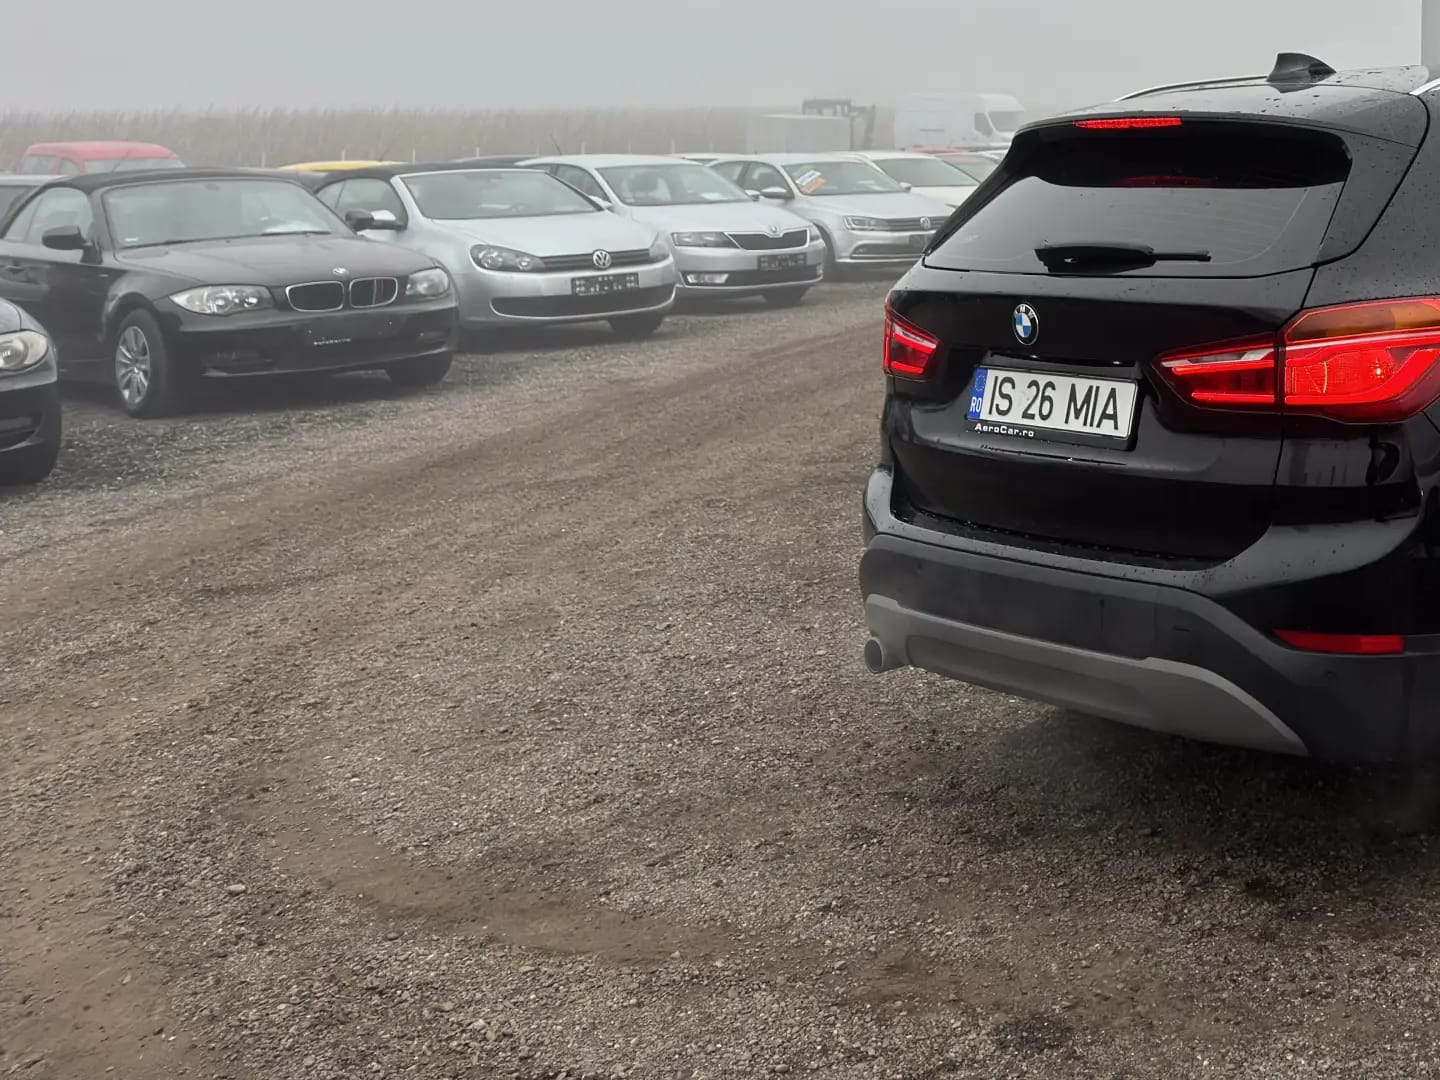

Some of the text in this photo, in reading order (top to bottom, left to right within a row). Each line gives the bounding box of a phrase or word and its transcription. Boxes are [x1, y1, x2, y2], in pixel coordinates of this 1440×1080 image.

[970, 397, 982, 413] RO
[989, 376, 1119, 431] IS 26 MIA
[974, 423, 1035, 437] AeroCar.ro
